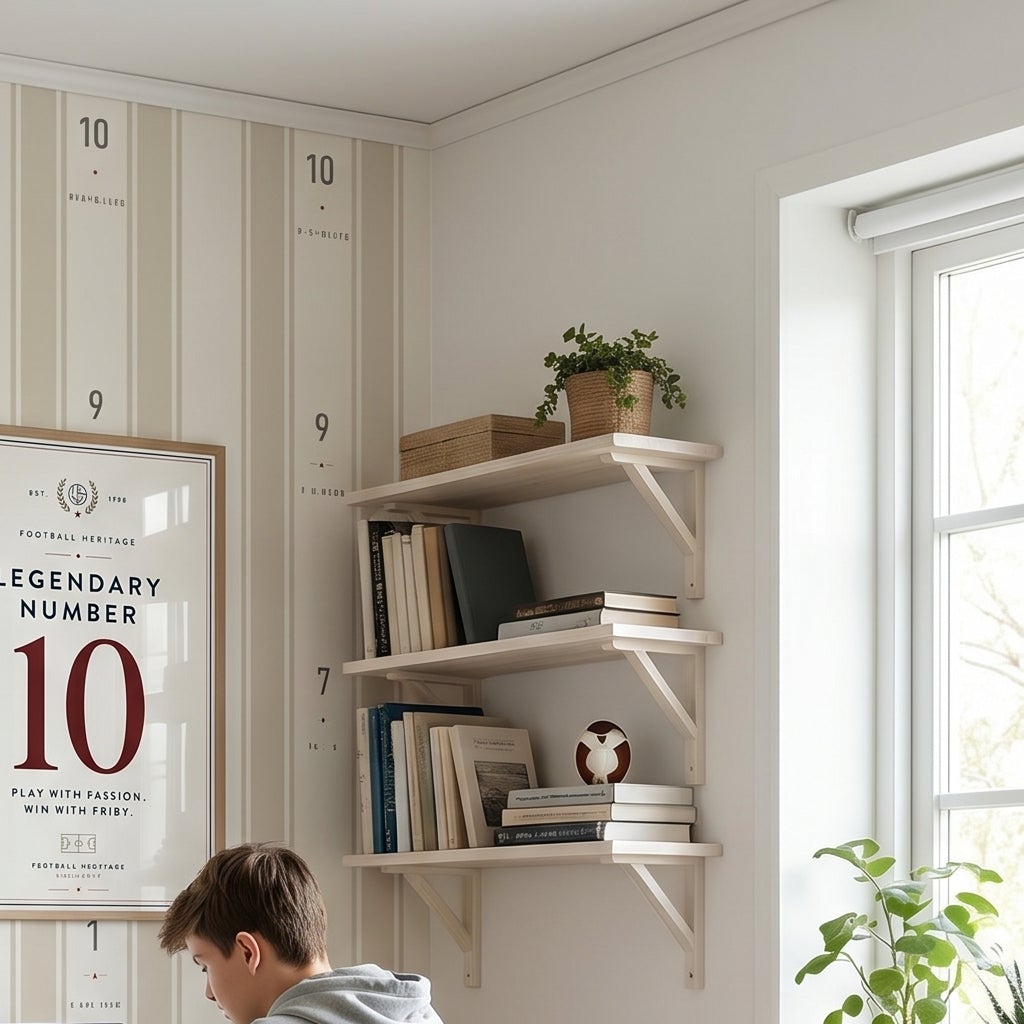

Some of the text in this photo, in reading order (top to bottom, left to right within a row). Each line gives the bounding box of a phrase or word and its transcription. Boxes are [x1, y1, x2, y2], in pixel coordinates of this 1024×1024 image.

[79, 116, 109, 150] 10
[306, 153, 334, 186] 10
[88, 389, 103, 420] 9
[315, 412, 329, 442] 9
[19, 529, 135, 547] FOOTBALL HERITAGE
[20, 598, 136, 625] NUMBER
[317, 667, 331, 696] 7
[13, 635, 146, 775] 10
[11, 787, 44, 798] PLAY
[48, 789, 81, 800] WITH
[23, 804, 133, 817] WIN WITH FRIBY.
[87, 919, 99, 952] 1
